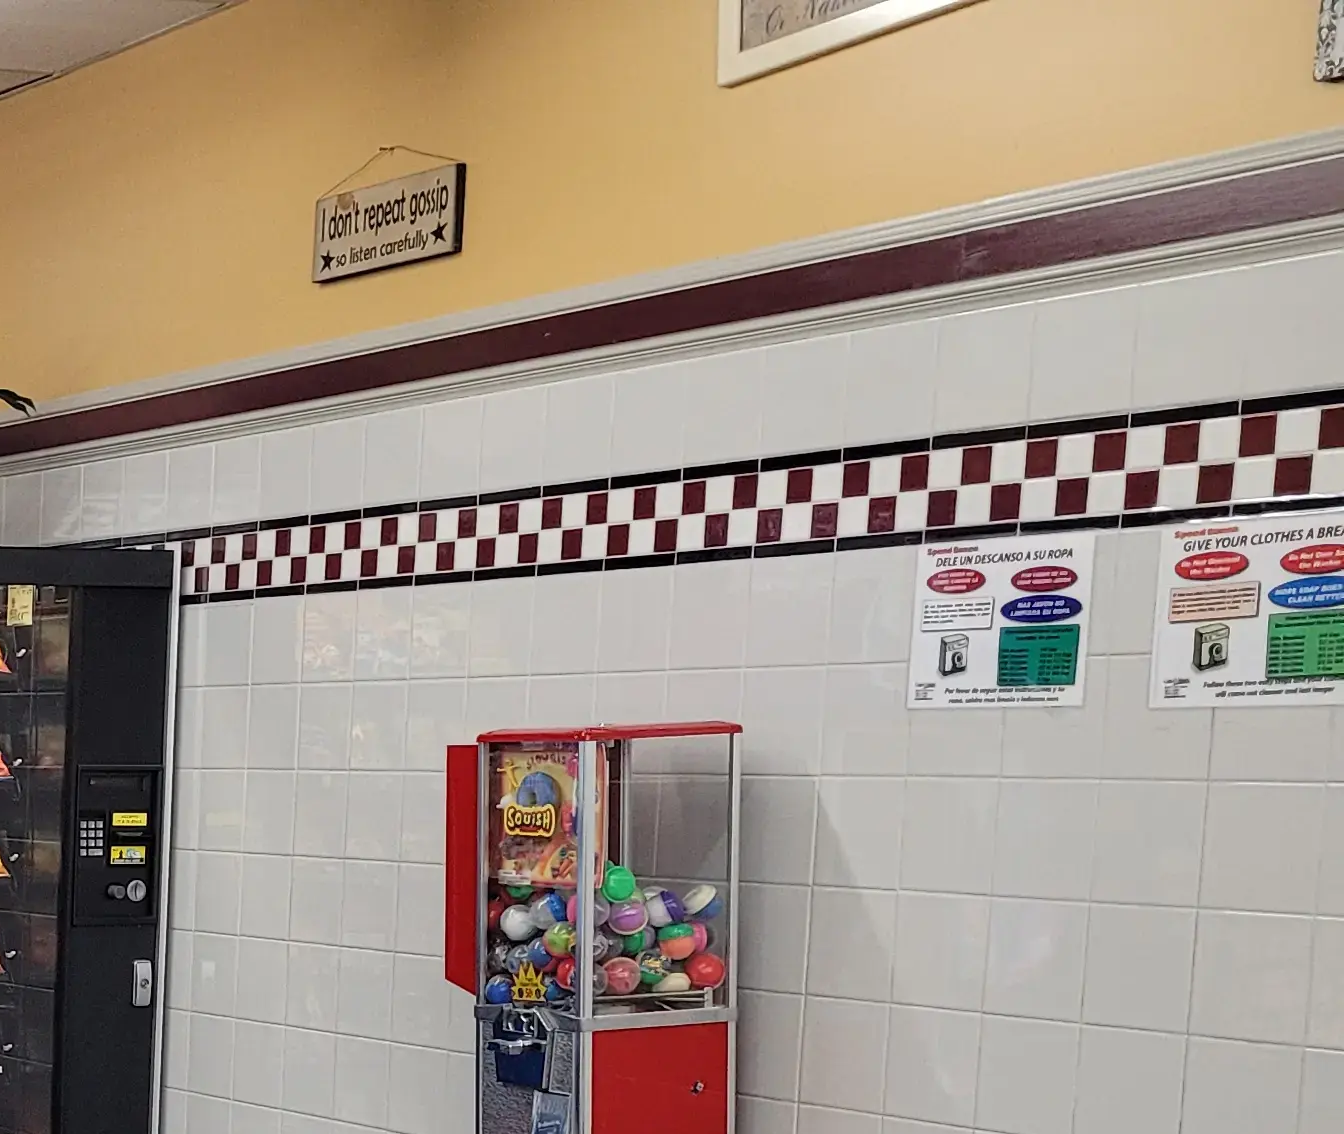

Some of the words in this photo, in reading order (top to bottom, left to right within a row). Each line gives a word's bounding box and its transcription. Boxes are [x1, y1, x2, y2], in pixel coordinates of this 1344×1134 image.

[321, 208, 326, 242] I
[328, 200, 360, 240] don't
[363, 189, 406, 236] repeat
[409, 178, 449, 225] gossip
[335, 254, 347, 268] so
[349, 245, 377, 265] listen
[380, 229, 429, 257] carefully
[1183, 539, 1212, 552] GIVE
[1215, 535, 1248, 549] YOUR
[1250, 529, 1304, 546] CLOTHES
[1306, 528, 1314, 540] A
[1316, 525, 1344, 539] BREA
[936, 557, 959, 567] DELE
[960, 555, 973, 566] UN
[974, 551, 1023, 565] DESCANSO
[1025, 551, 1031, 561] A
[1033, 550, 1047, 560] SU
[1047, 548, 1073, 559] ROPA
